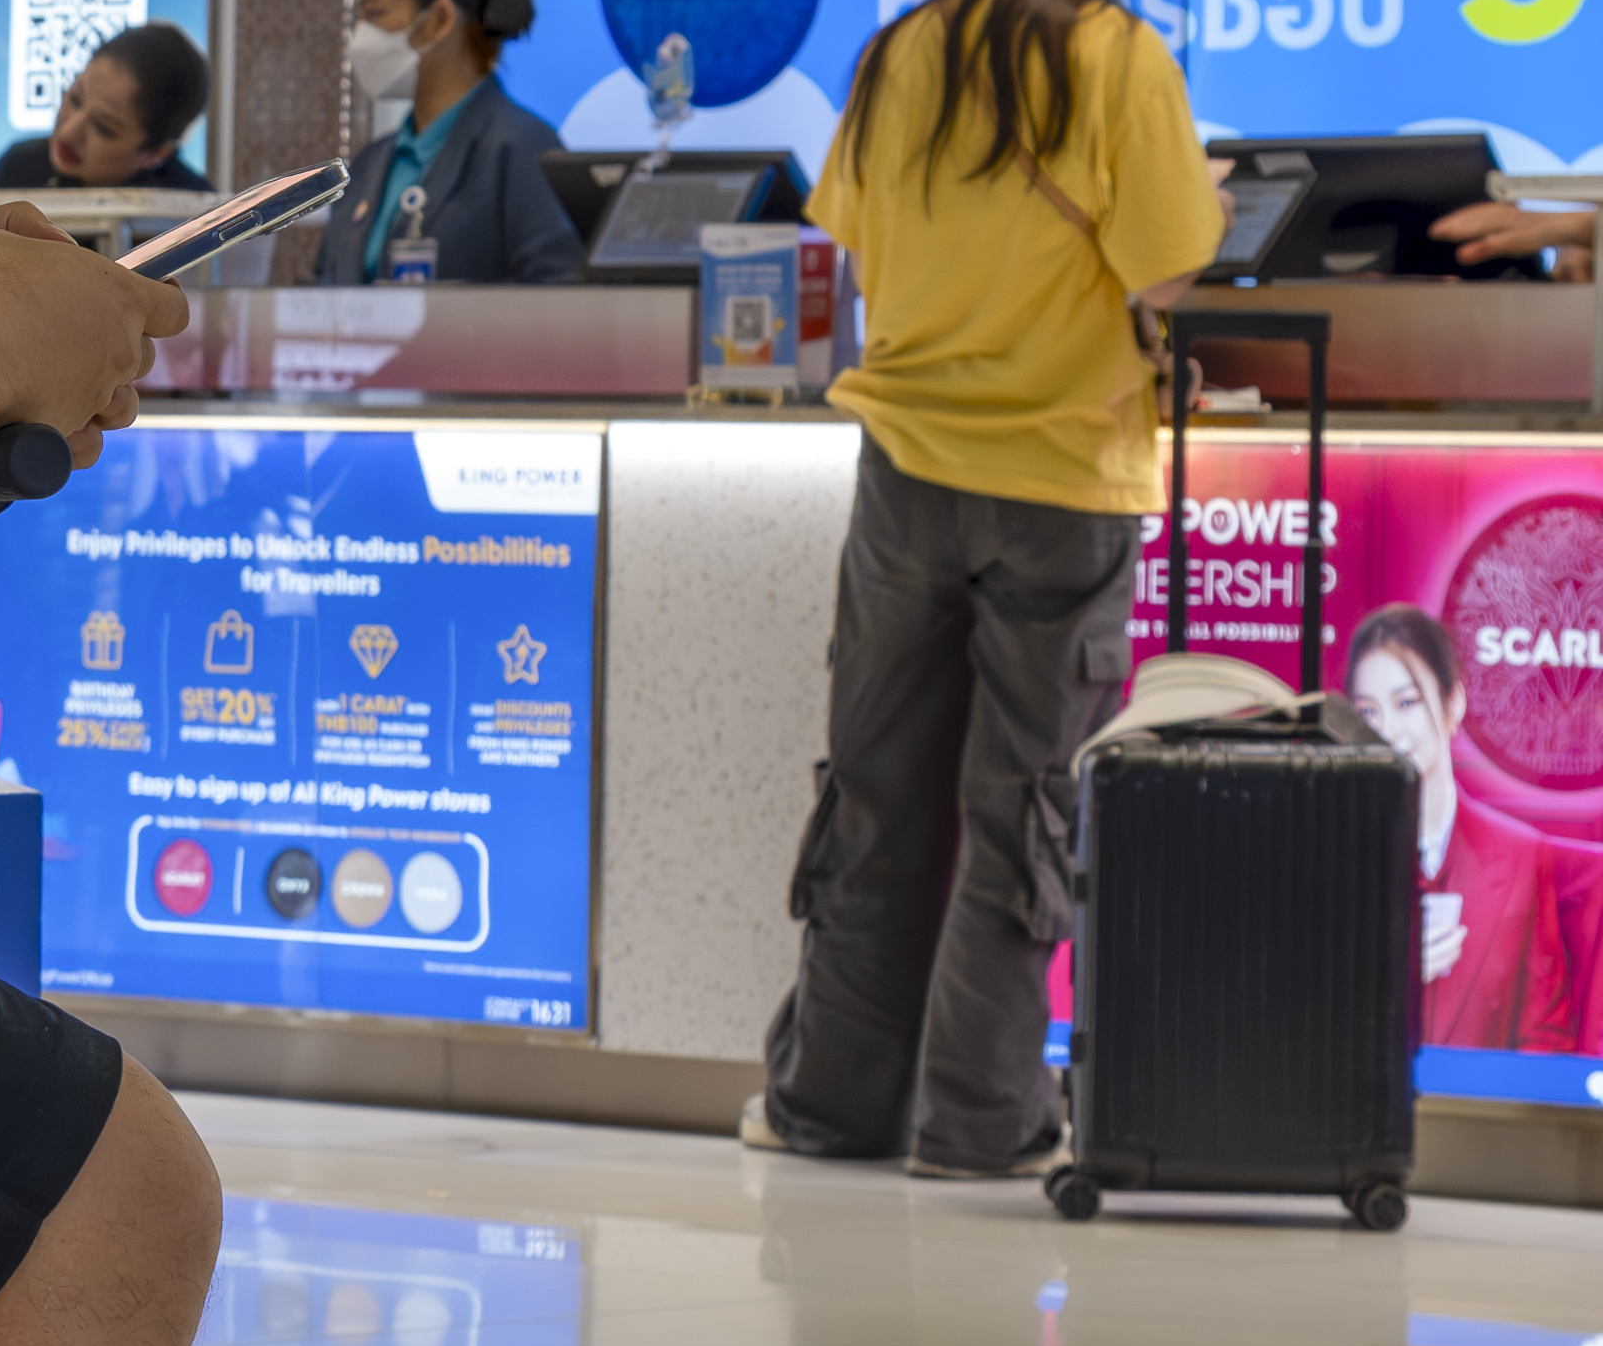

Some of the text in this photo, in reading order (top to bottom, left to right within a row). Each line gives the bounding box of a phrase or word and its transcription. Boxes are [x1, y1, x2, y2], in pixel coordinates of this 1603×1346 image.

[66, 528, 572, 569] Enjoy Privileges to Unlock Endless Possibilities
[240, 565, 382, 597] for Travellers
[350, 693, 406, 716] CARAT
[128, 771, 175, 802] Easy
[175, 773, 197, 799] to
[198, 774, 239, 805] sign
[239, 781, 267, 806] up
[320, 780, 366, 813] King
[367, 783, 429, 811] Power
[430, 786, 492, 814] stores
